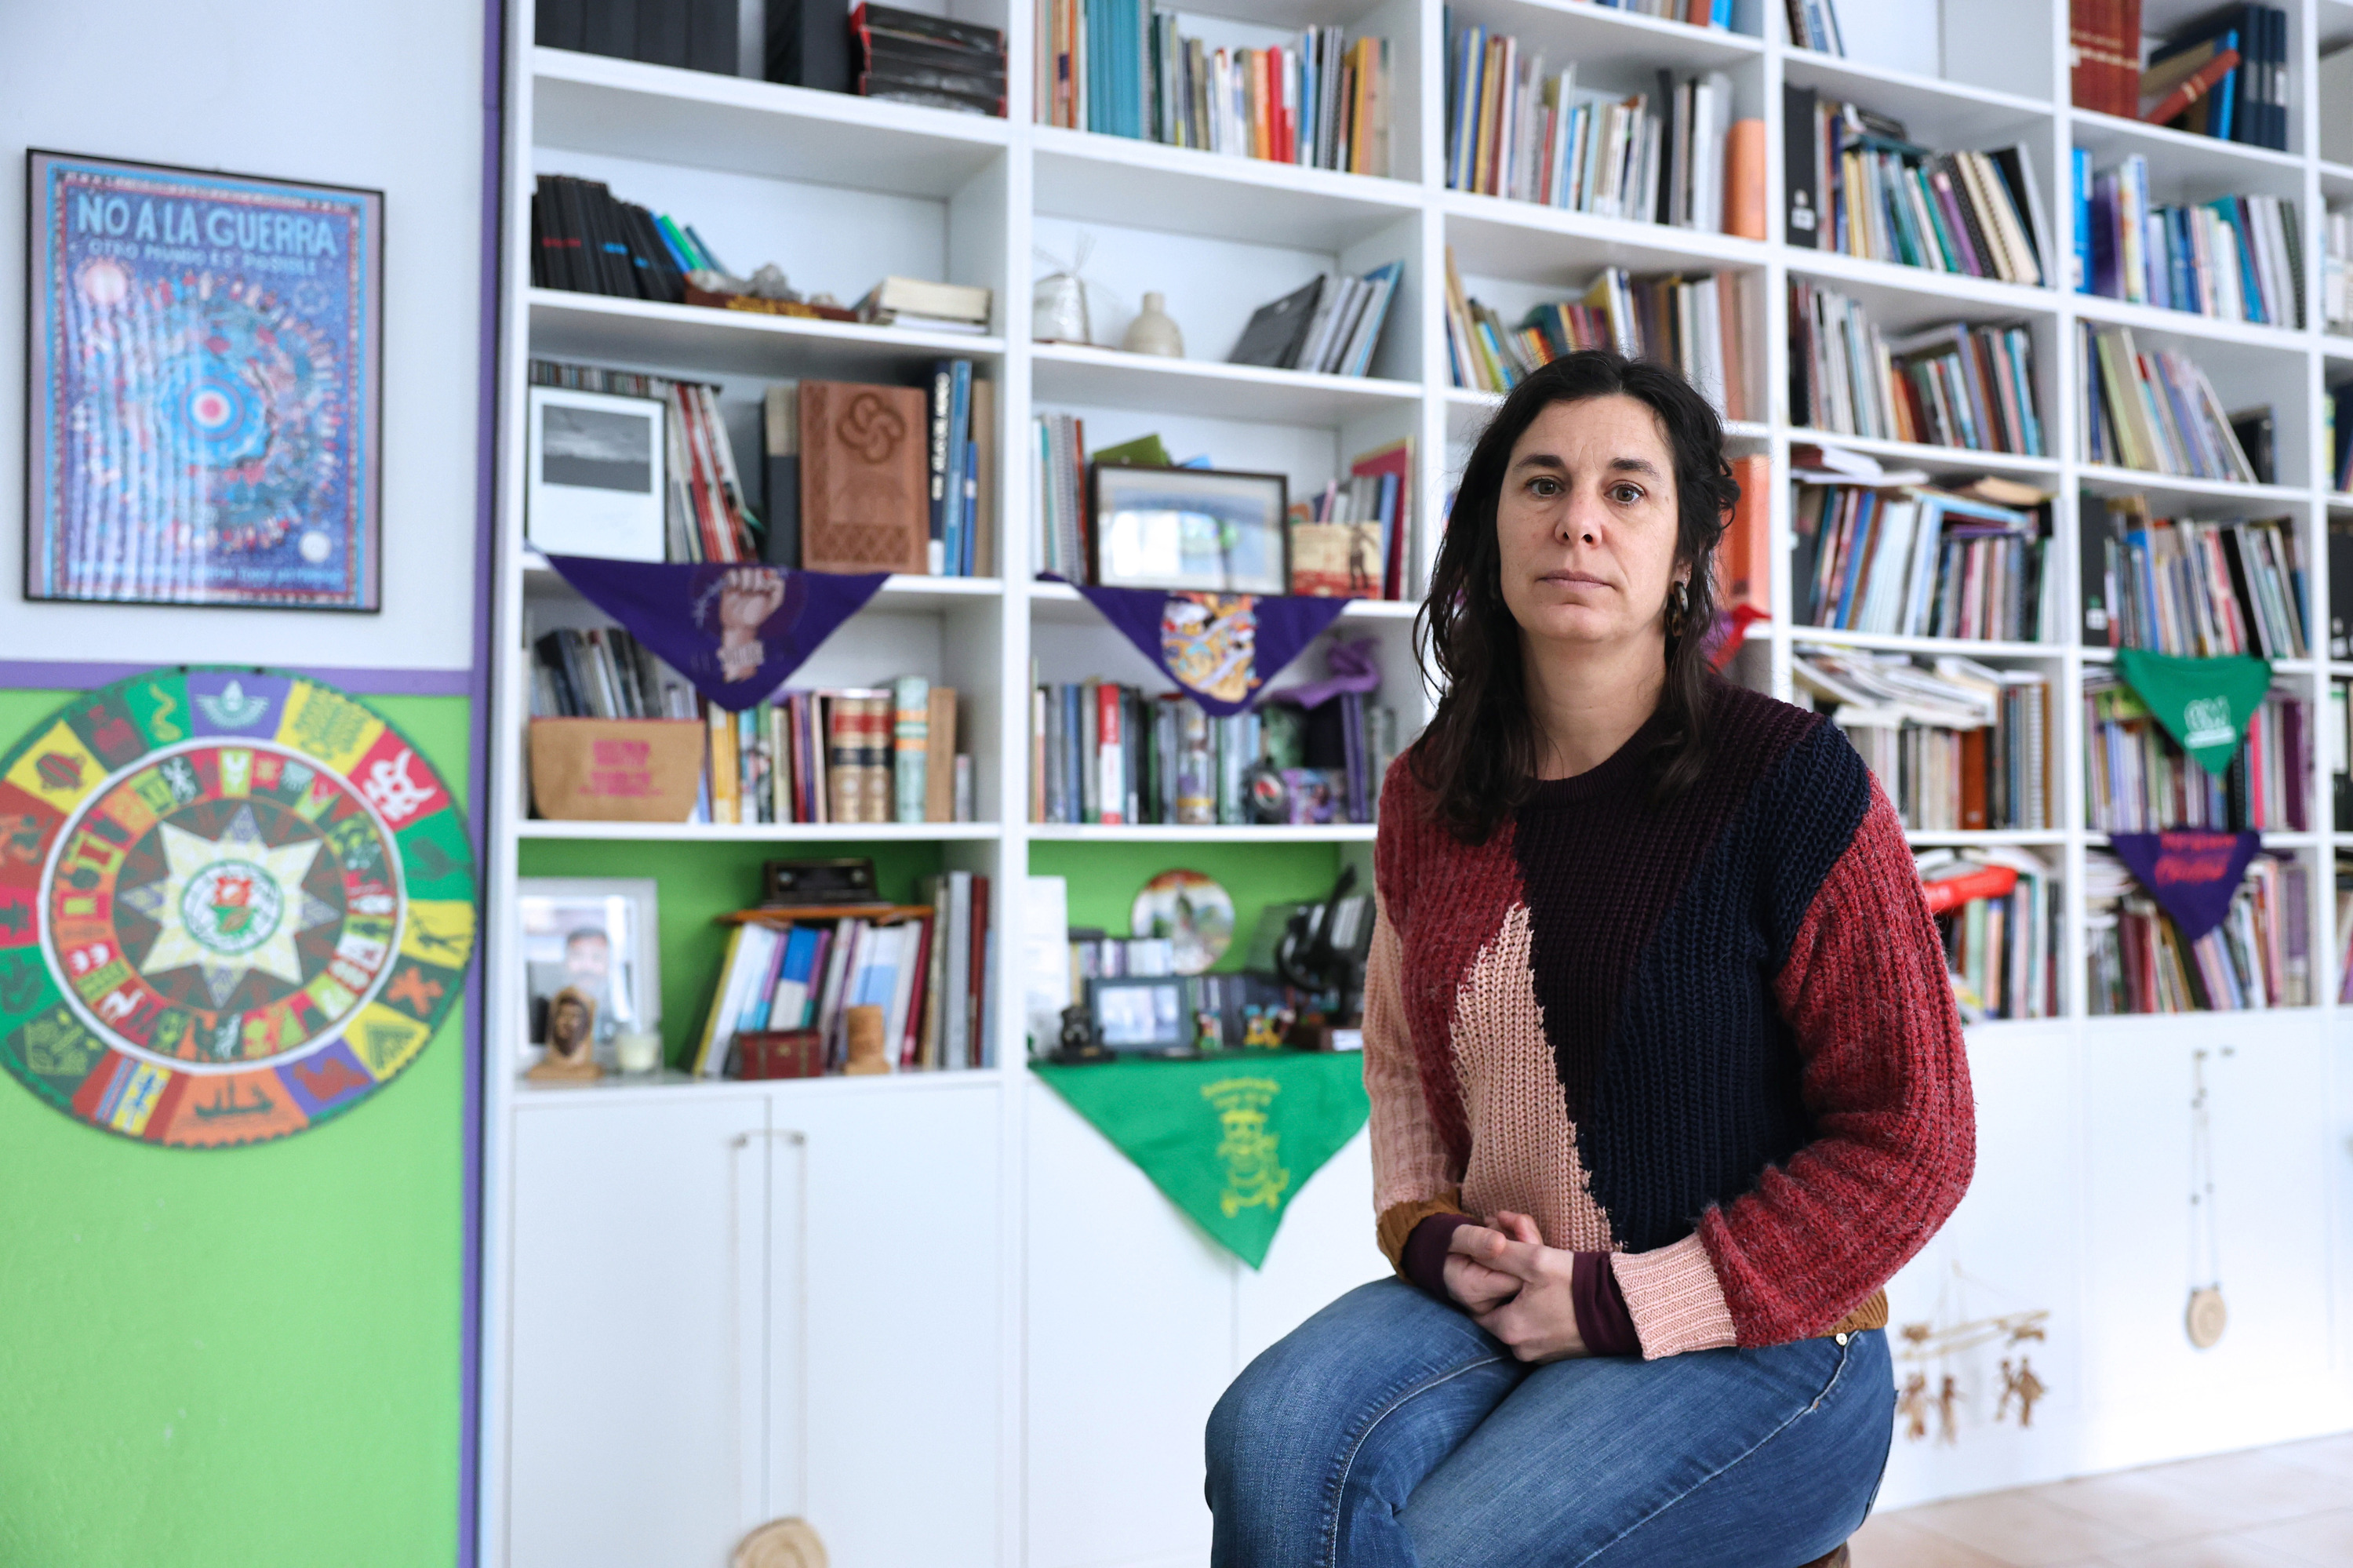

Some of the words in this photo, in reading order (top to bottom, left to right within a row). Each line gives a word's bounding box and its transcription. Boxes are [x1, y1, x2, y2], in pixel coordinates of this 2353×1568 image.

[78, 194, 131, 236] NO
[136, 199, 157, 241] A
[163, 202, 199, 247] LA
[205, 207, 339, 257] GUERRA
